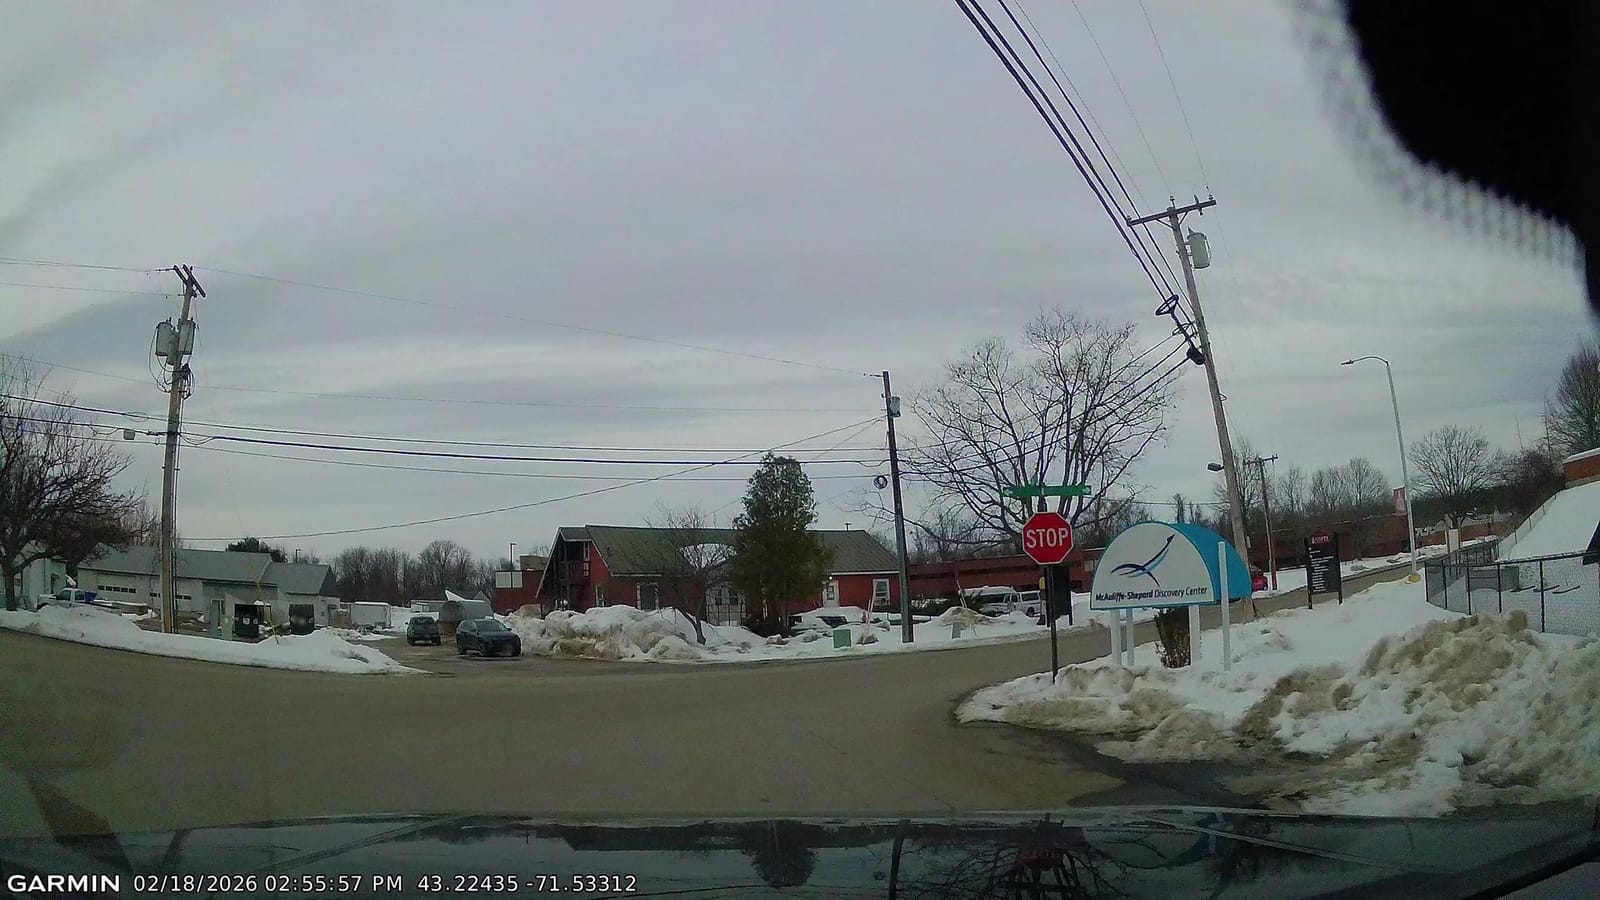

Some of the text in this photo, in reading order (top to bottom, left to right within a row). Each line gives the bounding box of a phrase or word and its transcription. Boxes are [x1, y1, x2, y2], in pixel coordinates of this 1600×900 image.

[1026, 527, 1069, 549] STOP
[1095, 586, 1207, 602] McAuliffe-Shepard Discovery Center
